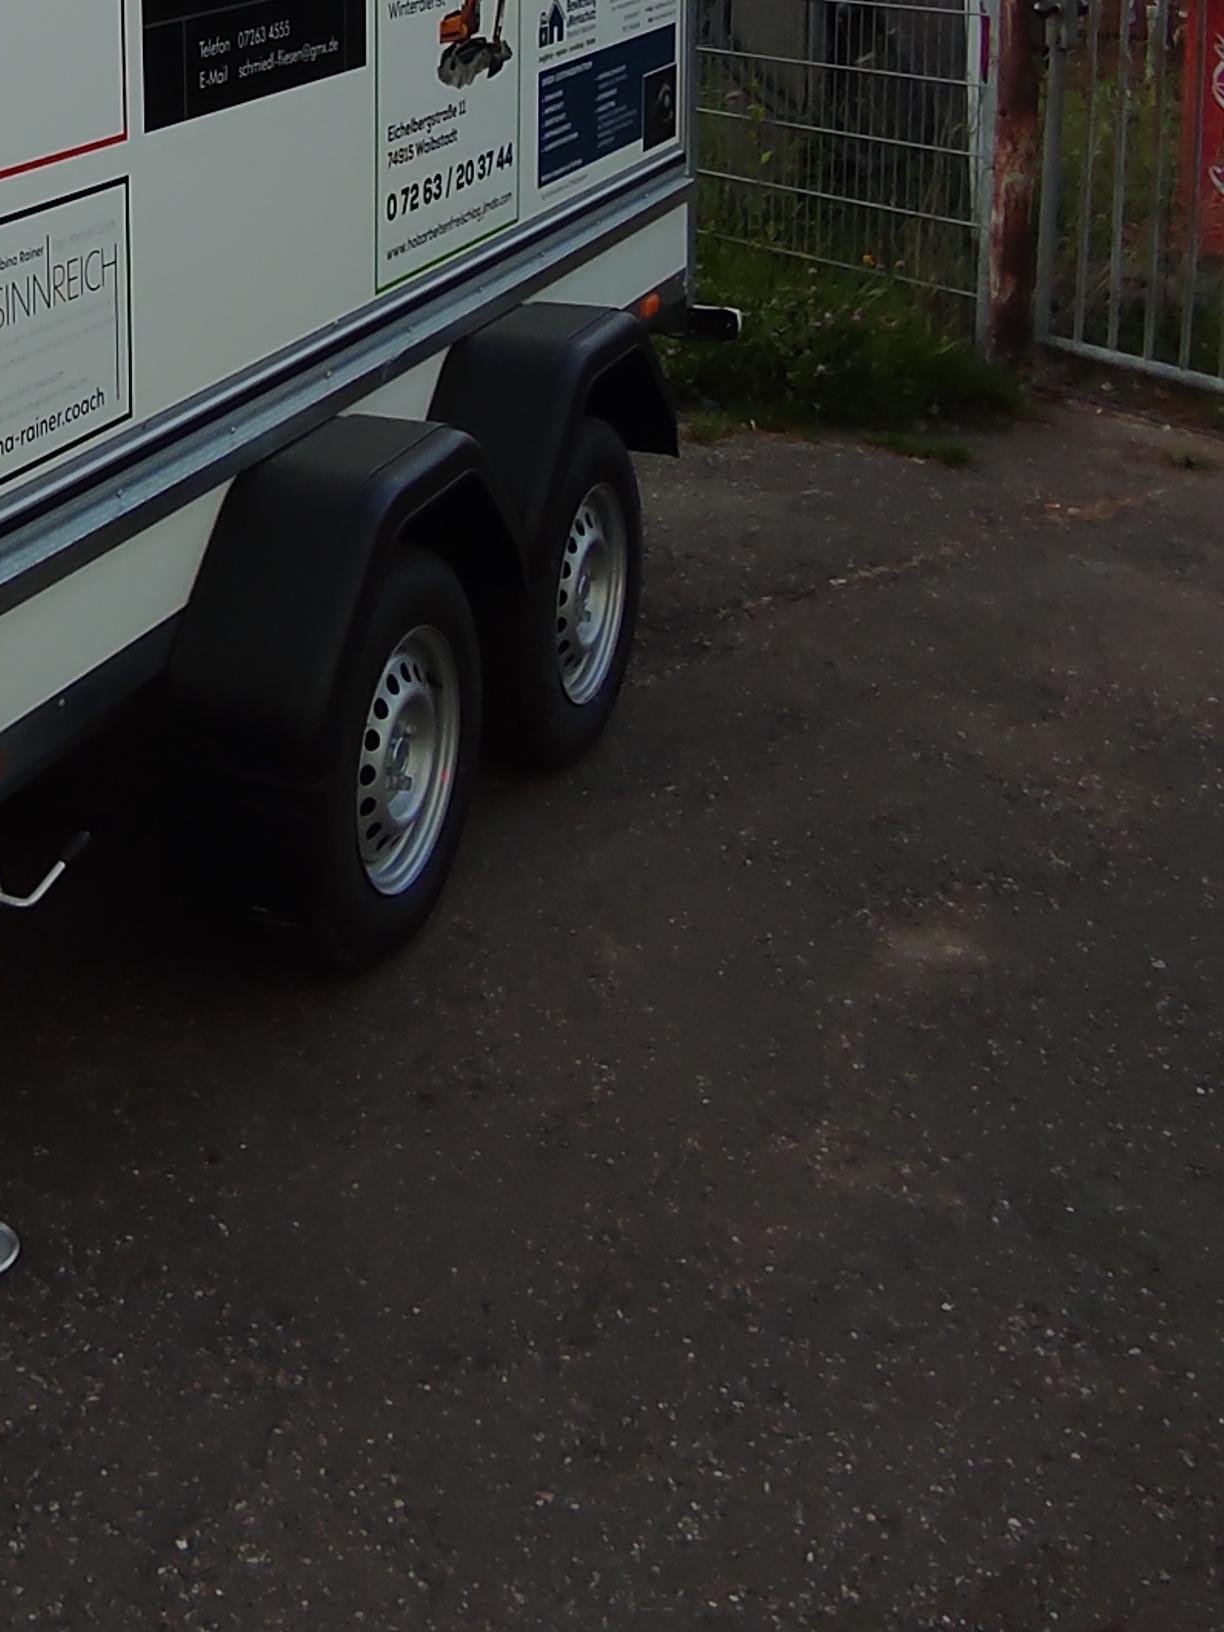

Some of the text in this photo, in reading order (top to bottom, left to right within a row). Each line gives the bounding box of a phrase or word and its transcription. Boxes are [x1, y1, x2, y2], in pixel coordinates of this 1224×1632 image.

[198, 24, 267, 59] Telefon 07263
[199, 64, 228, 89] E-Mail
[386, 192, 398, 222] 0
[400, 181, 421, 217] 72
[423, 172, 444, 206] 63
[456, 158, 475, 192] 20
[477, 149, 494, 182] 37
[496, 141, 514, 171] 44
[19, 244, 45, 264] Rainer
